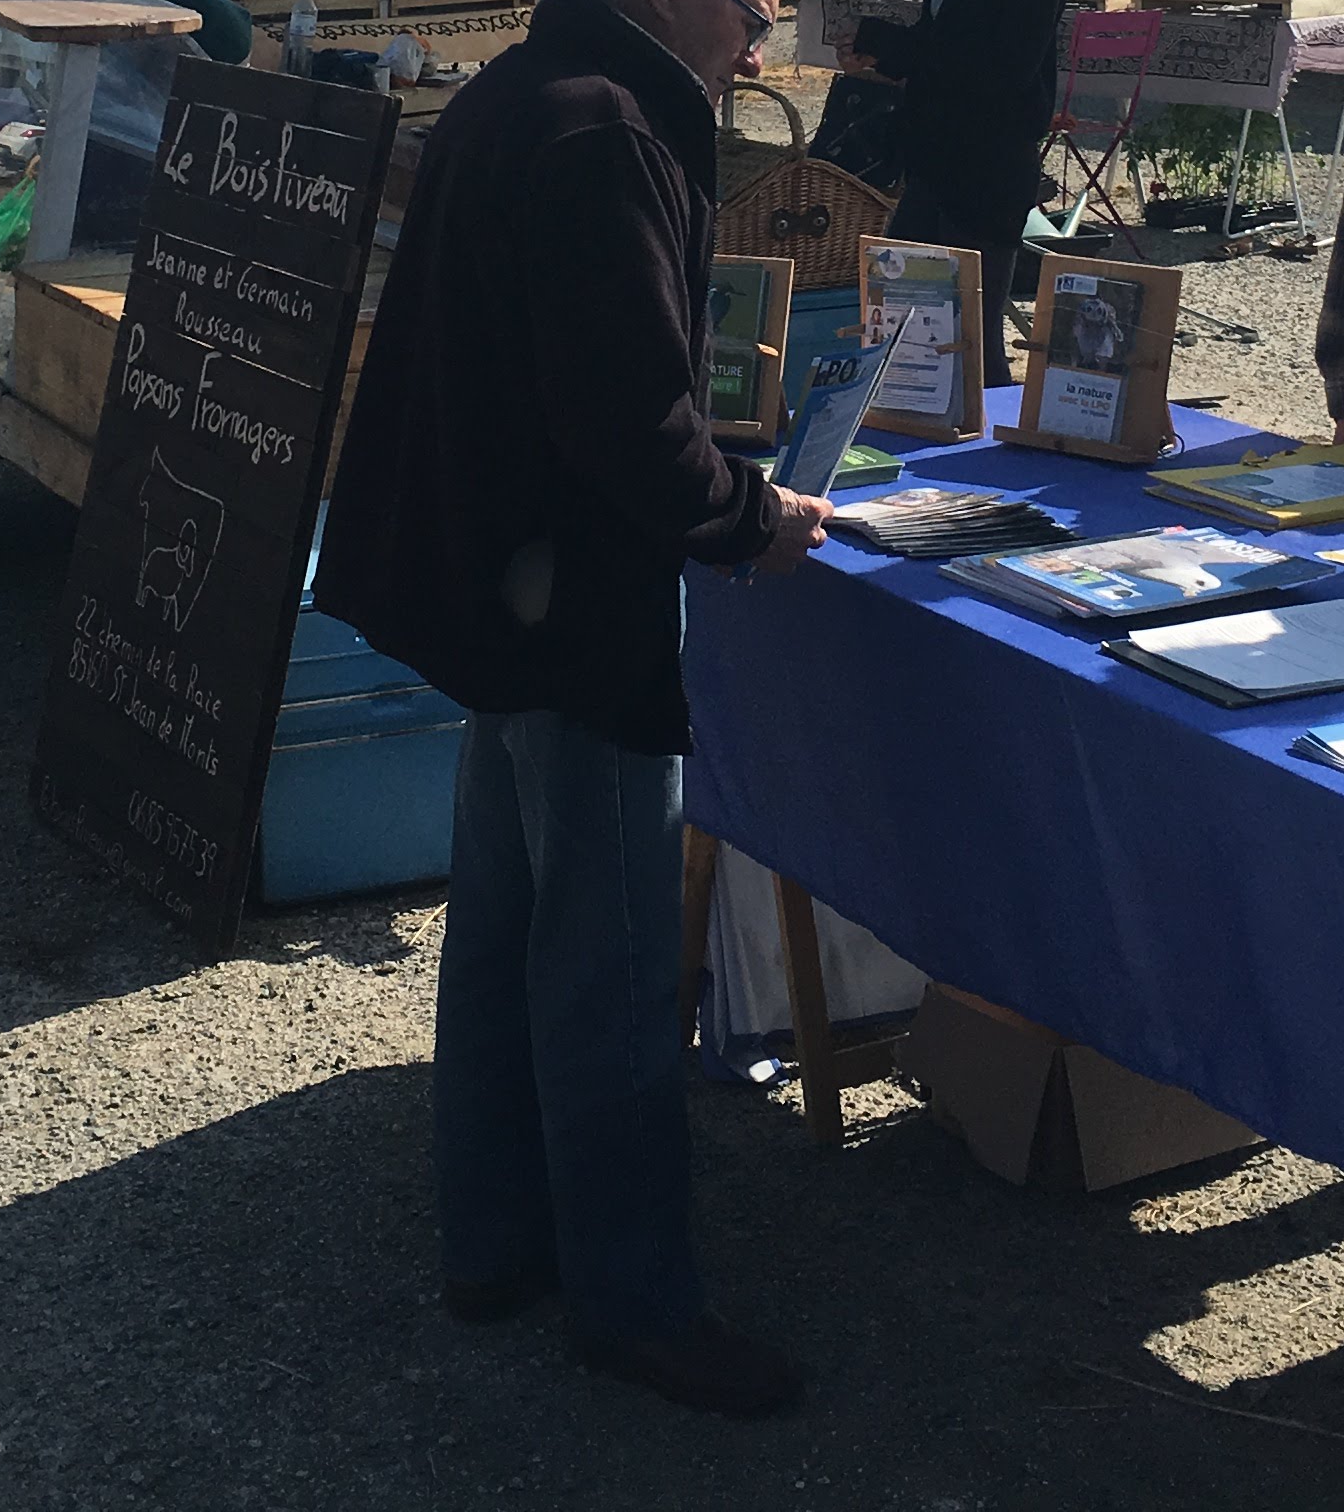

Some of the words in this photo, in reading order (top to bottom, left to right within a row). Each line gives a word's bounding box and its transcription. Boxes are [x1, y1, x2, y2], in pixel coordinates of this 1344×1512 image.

[163, 103, 194, 185] Le
[146, 233, 208, 285] Jeanne
[213, 261, 234, 290] et
[237, 265, 313, 323] Germain
[174, 290, 263, 356] Rousseau
[121, 322, 185, 419] Paysans
[191, 350, 296, 466] Fromagers
[709, 365, 744, 377] ATURE
[1066, 383, 1076, 394] la
[1078, 386, 1113, 400] nature
[1091, 400, 1111, 411] LPO
[75, 594, 97, 638] 22
[124, 674, 157, 735] Jean
